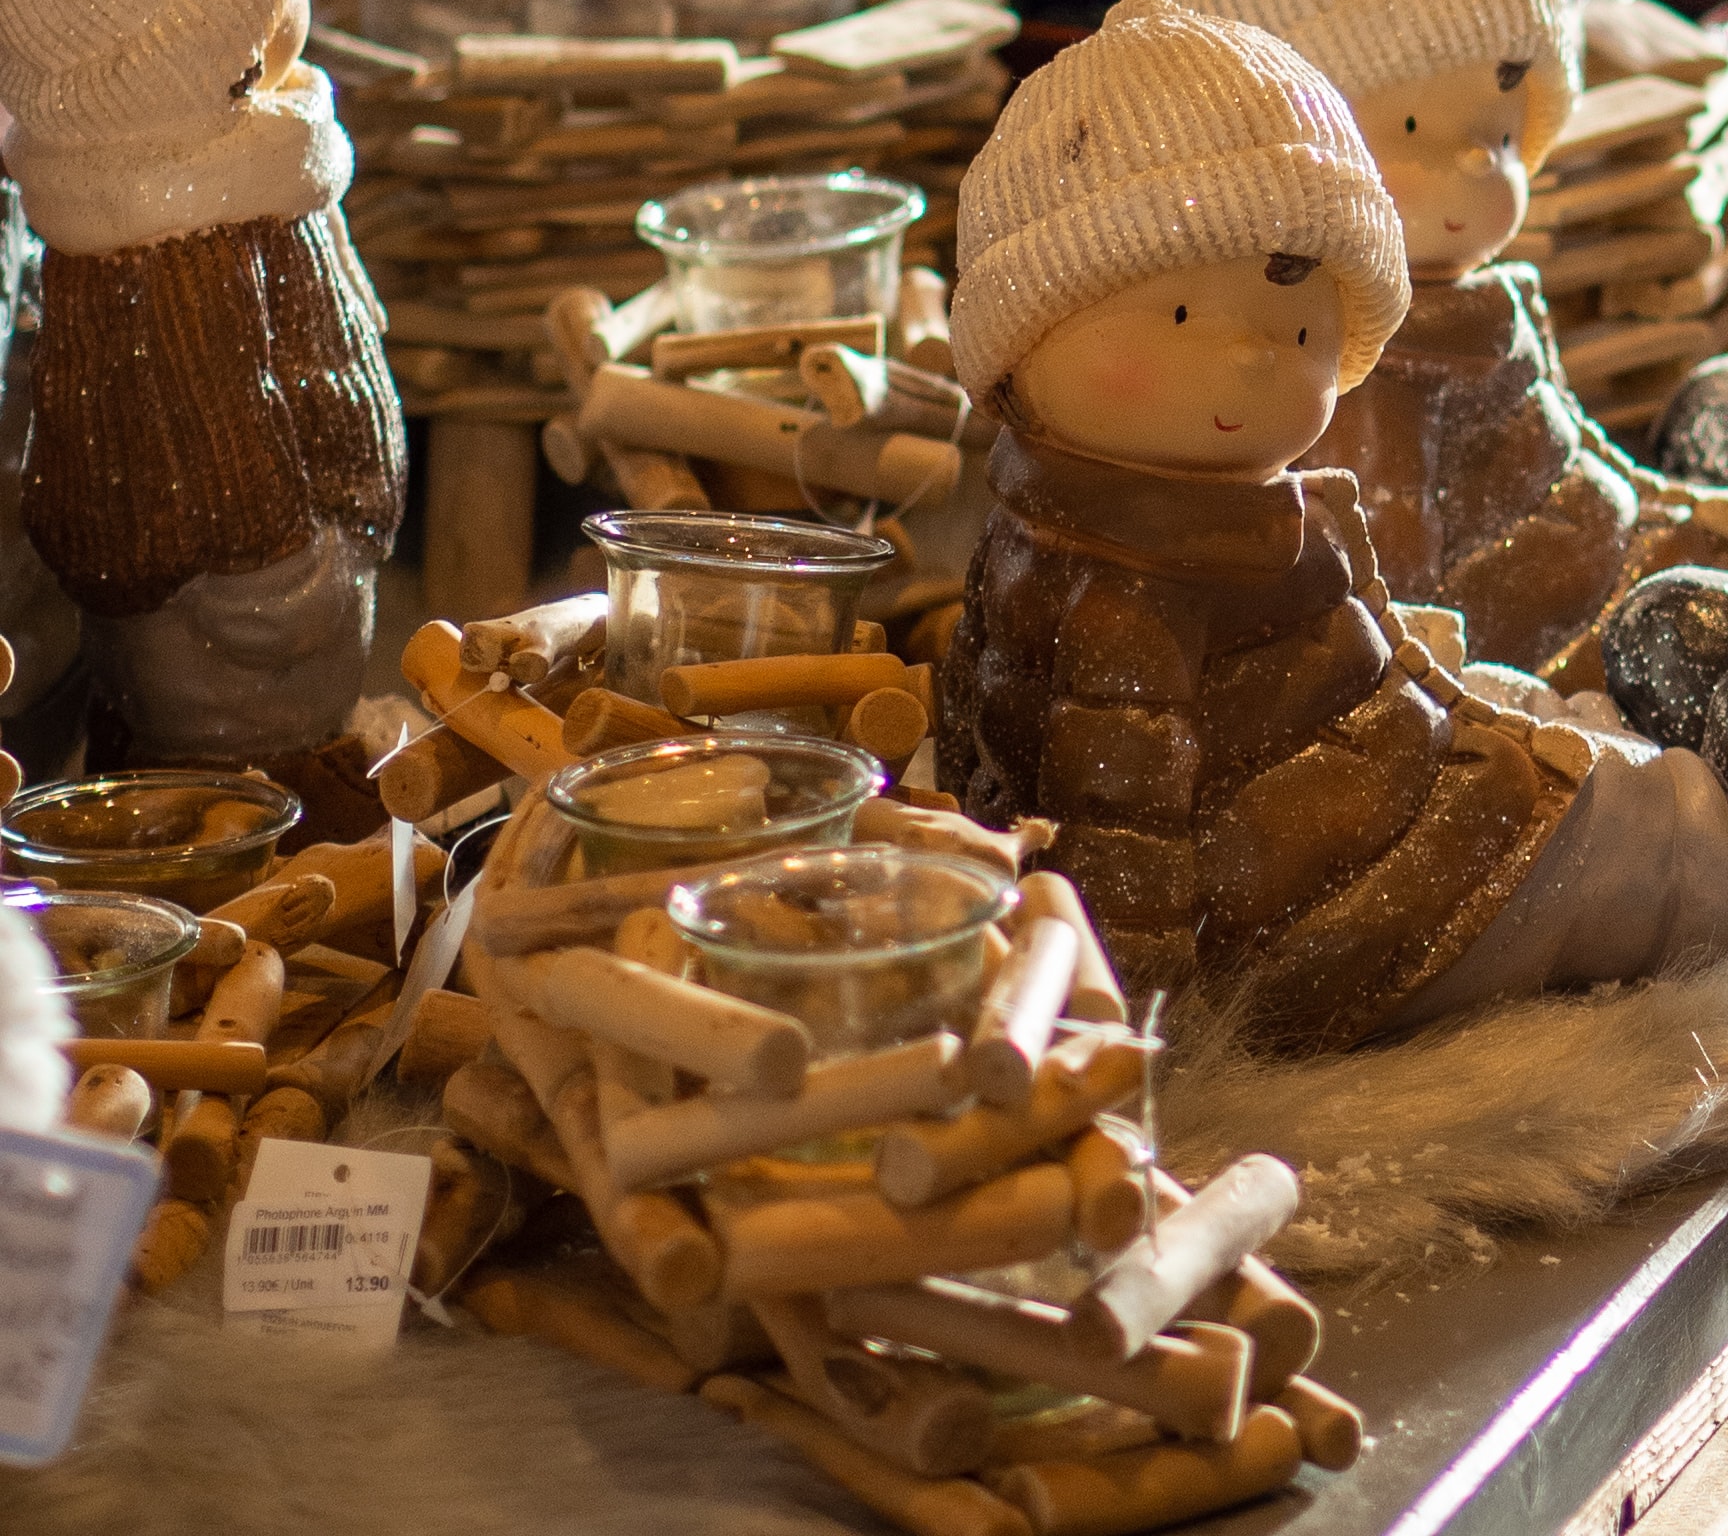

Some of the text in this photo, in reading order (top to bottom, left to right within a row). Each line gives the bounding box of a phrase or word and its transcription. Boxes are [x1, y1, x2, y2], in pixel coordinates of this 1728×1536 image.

[255, 1208, 322, 1221] Photophore
[366, 1204, 389, 1216] MM
[346, 1275, 389, 1292] 13.90
